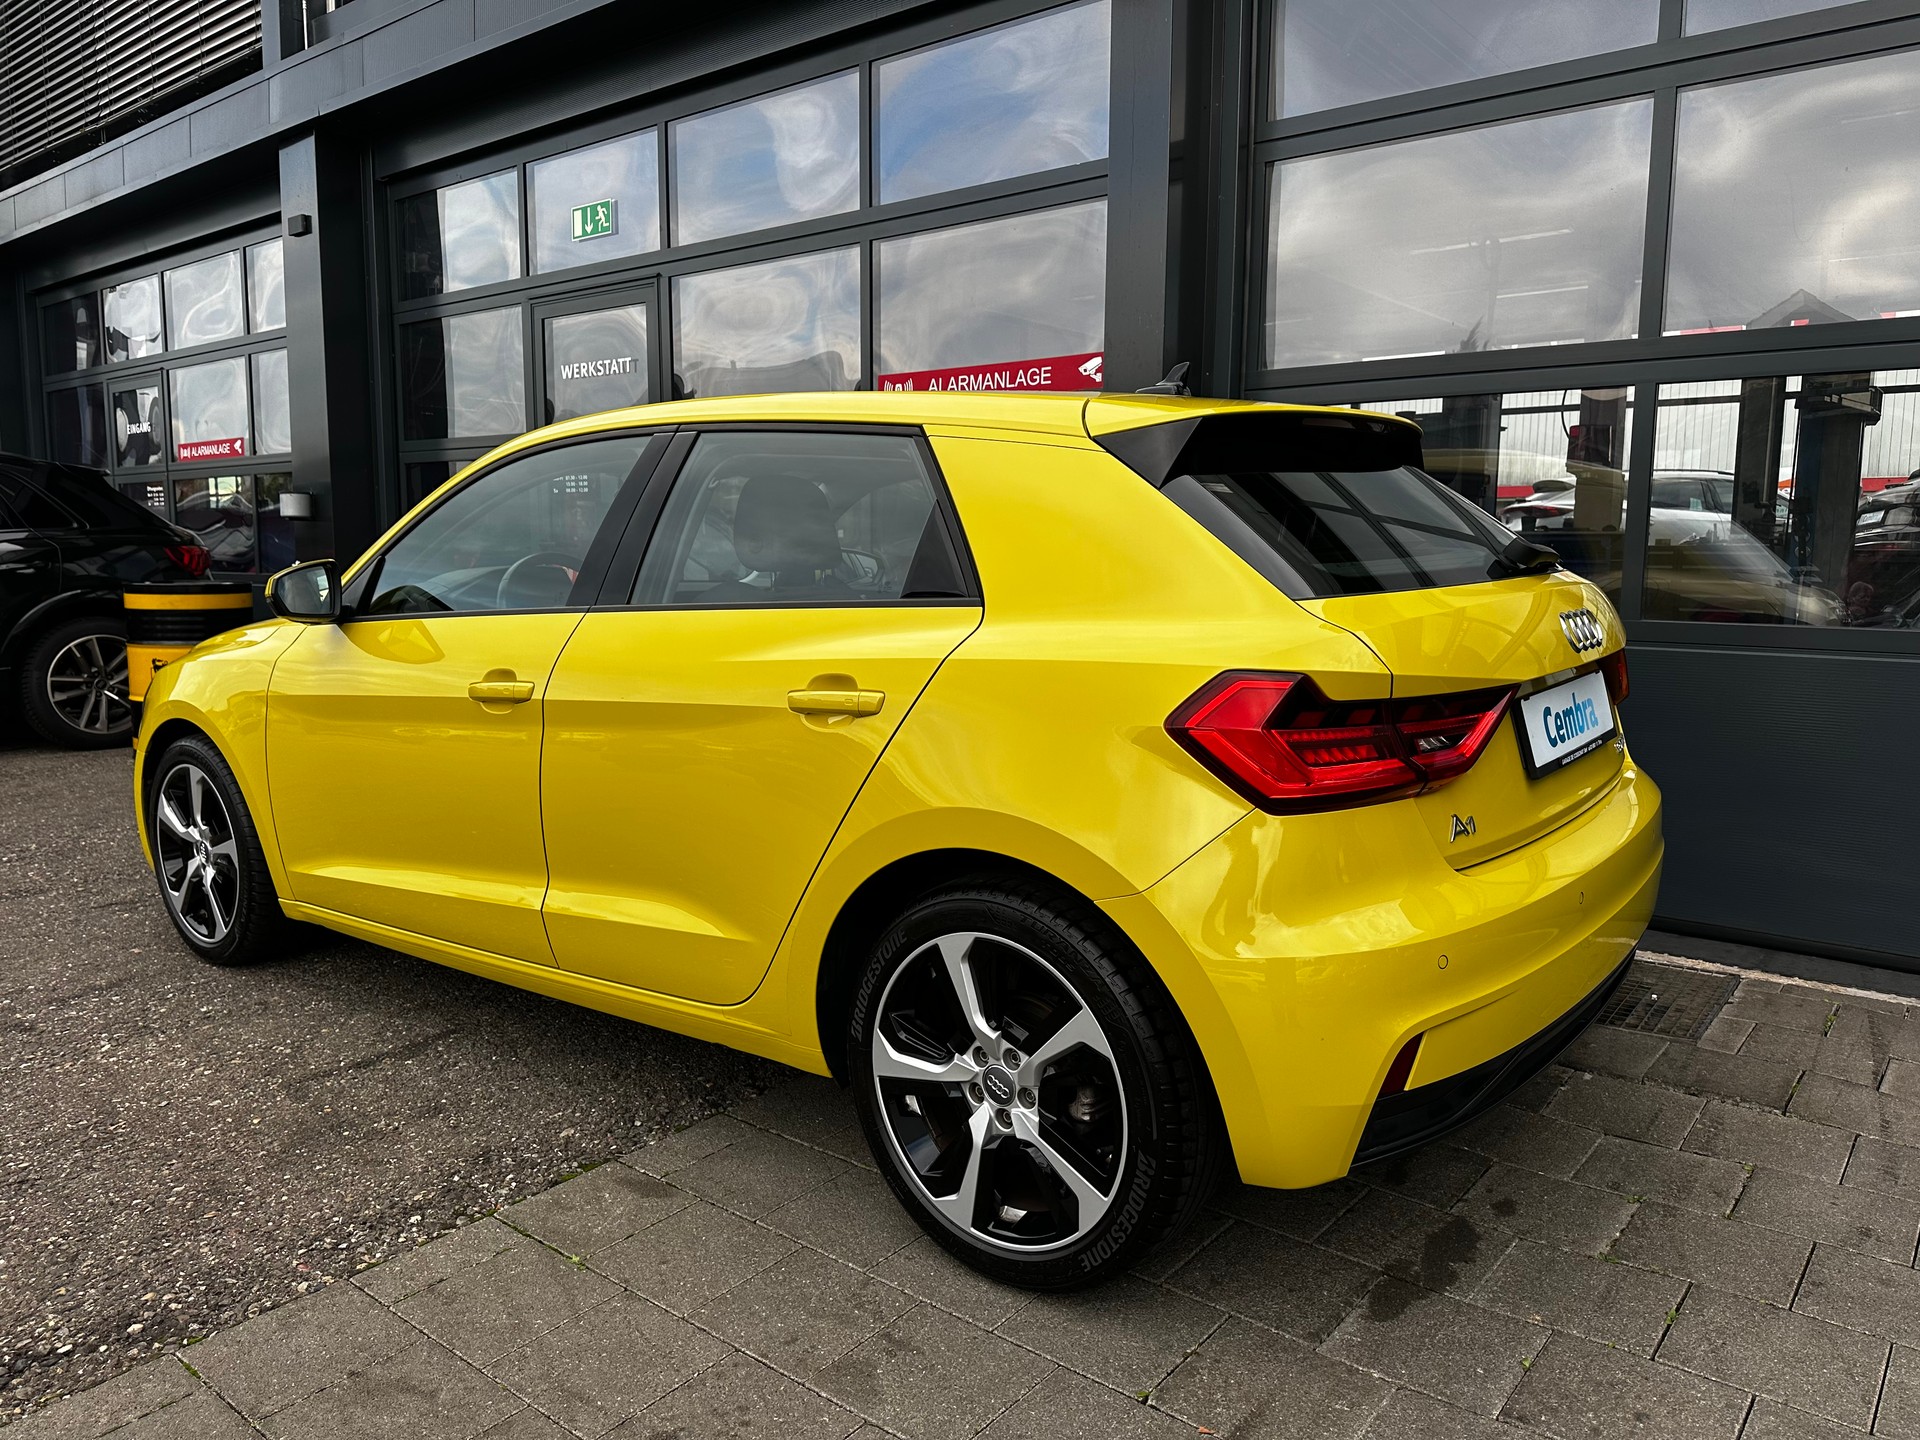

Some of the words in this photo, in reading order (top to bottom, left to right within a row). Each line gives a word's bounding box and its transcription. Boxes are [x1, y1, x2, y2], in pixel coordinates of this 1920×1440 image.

[560, 357, 632, 379] WERKSTATT
[928, 366, 1052, 391] ALARMANLAGE
[127, 422, 151, 434] EINGANG
[191, 443, 231, 457] ALARMANLAGE
[1542, 692, 1599, 749] Cembra
[1449, 813, 1477, 844] A1
[851, 928, 908, 1043] BRIDGESTONE
[1078, 1149, 1158, 1273] BRIDGESTONE
